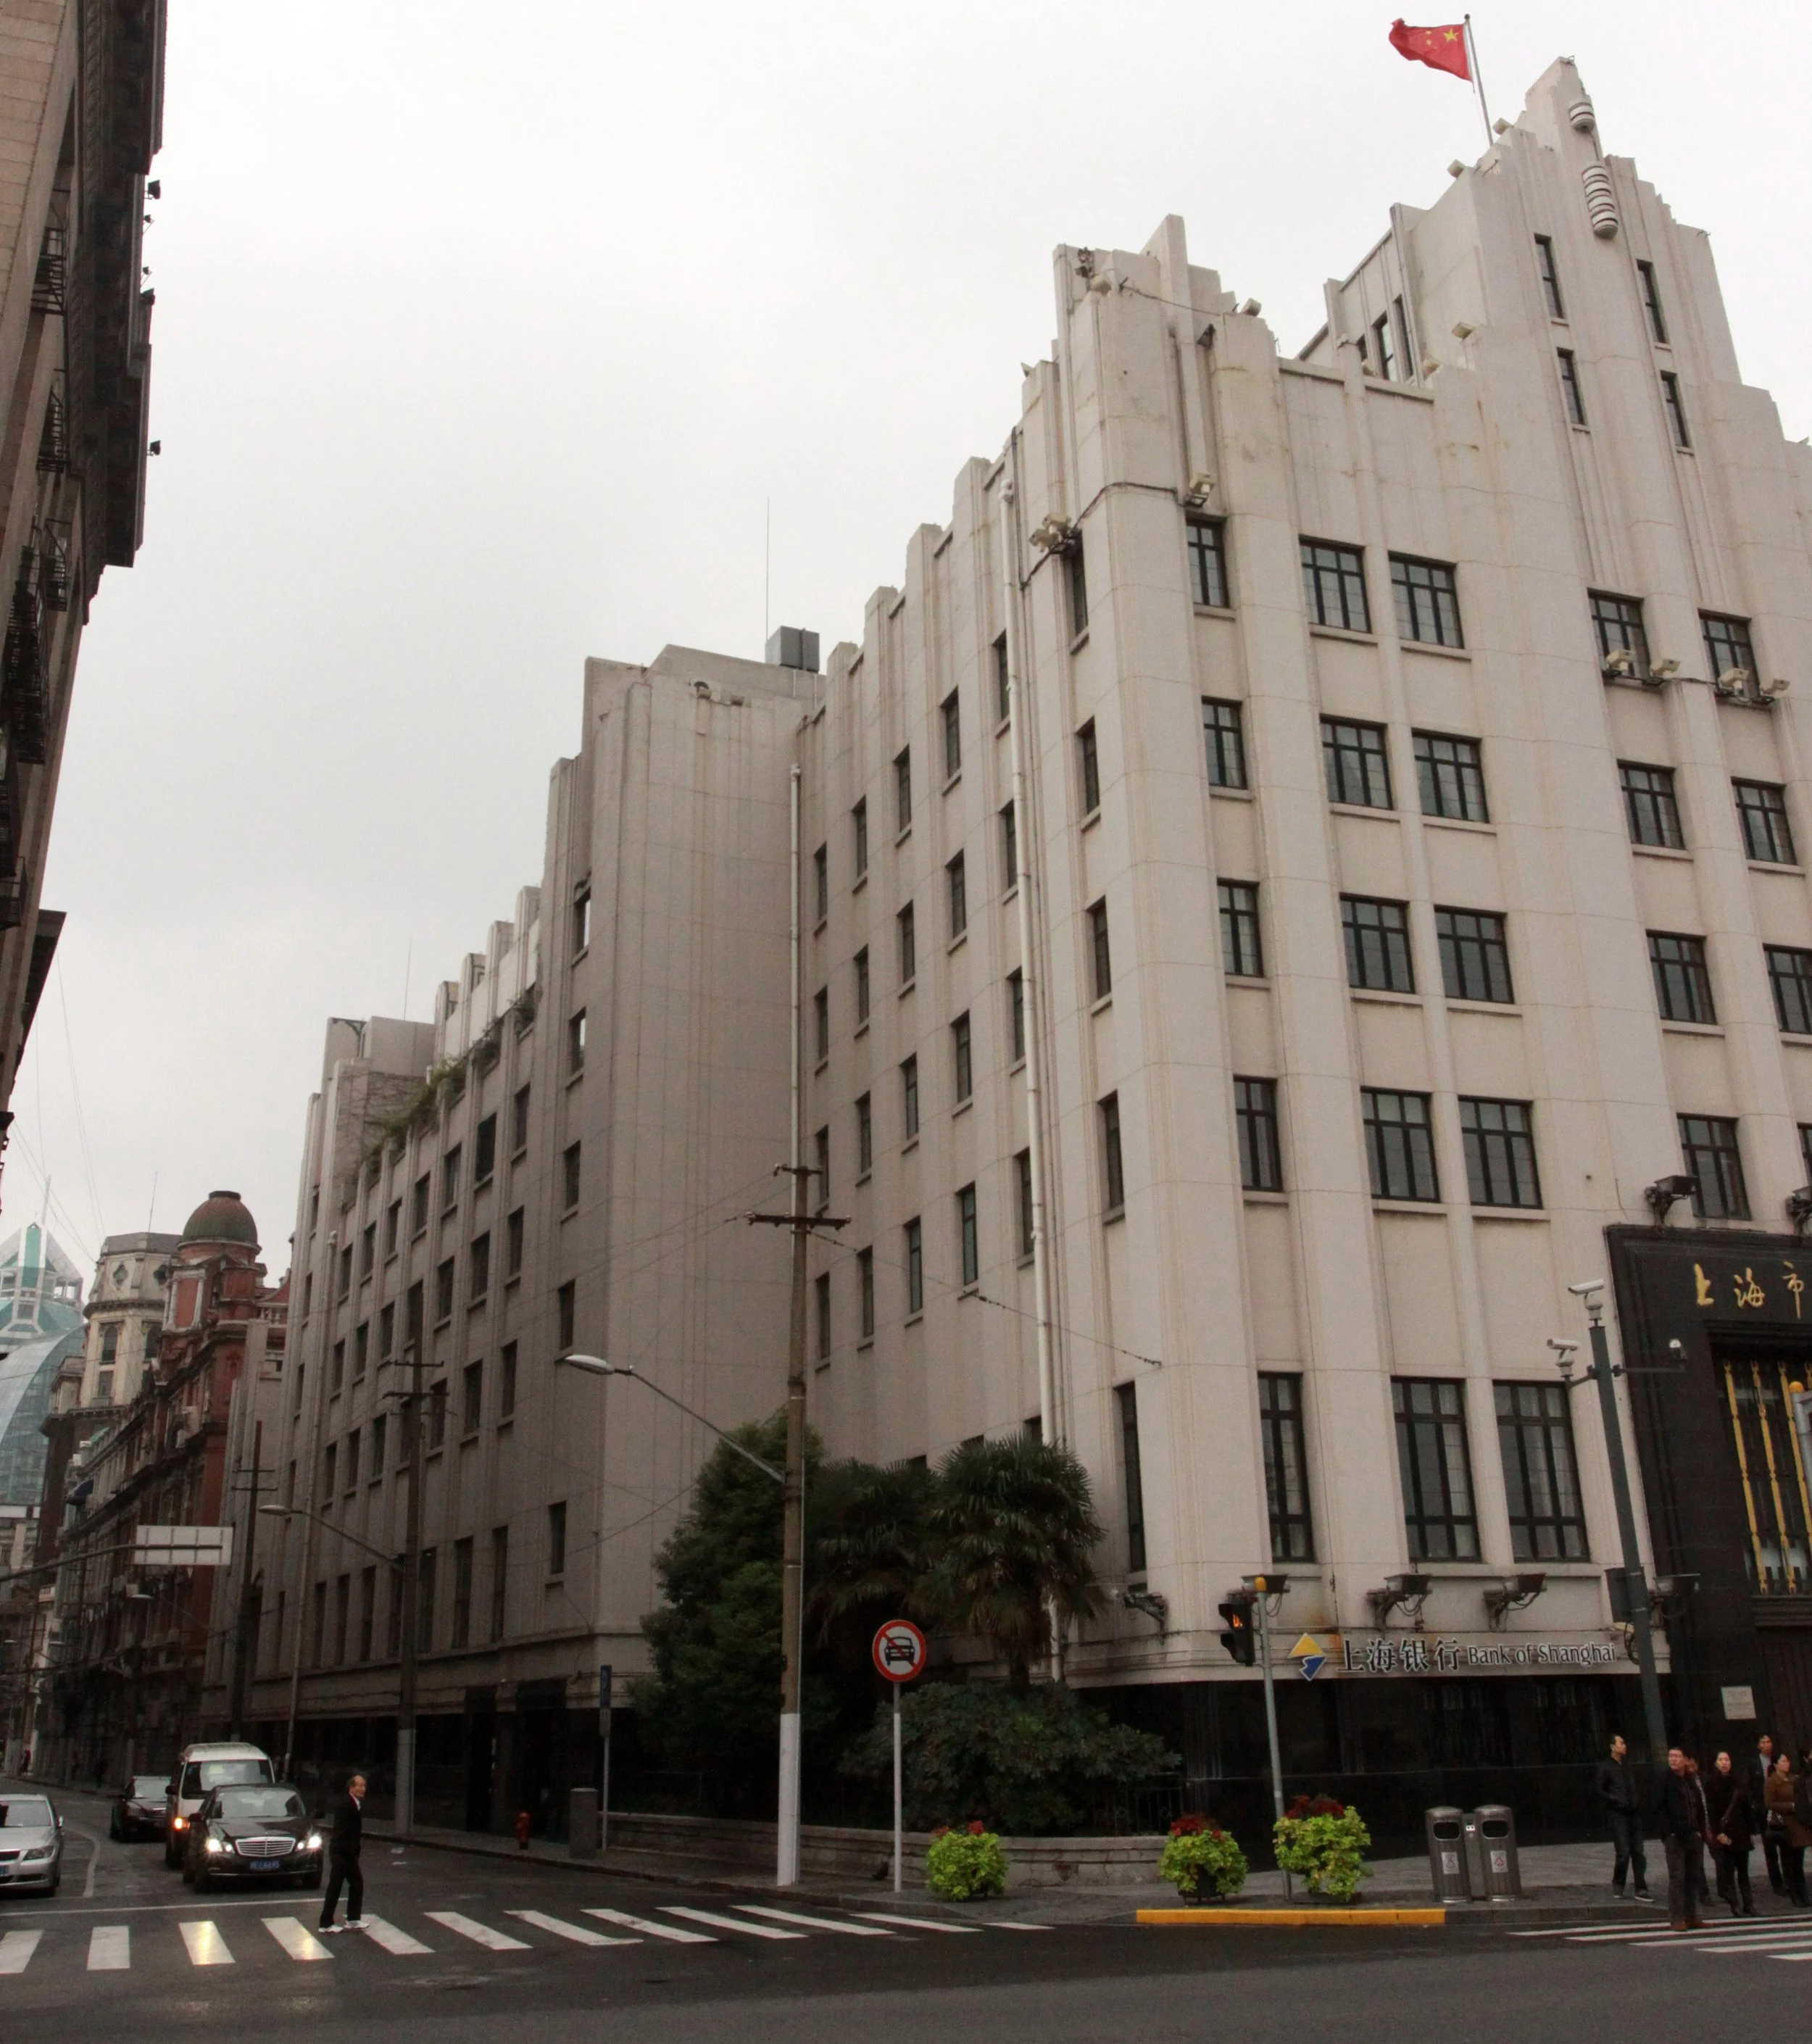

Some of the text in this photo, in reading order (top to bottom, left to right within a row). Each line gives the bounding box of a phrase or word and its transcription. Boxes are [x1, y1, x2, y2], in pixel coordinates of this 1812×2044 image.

[1694, 1260, 1805, 1319] 上海市
[1340, 1637, 1460, 1673] 上海银行
[1467, 1642, 1618, 1666] Bank of Shanghai
